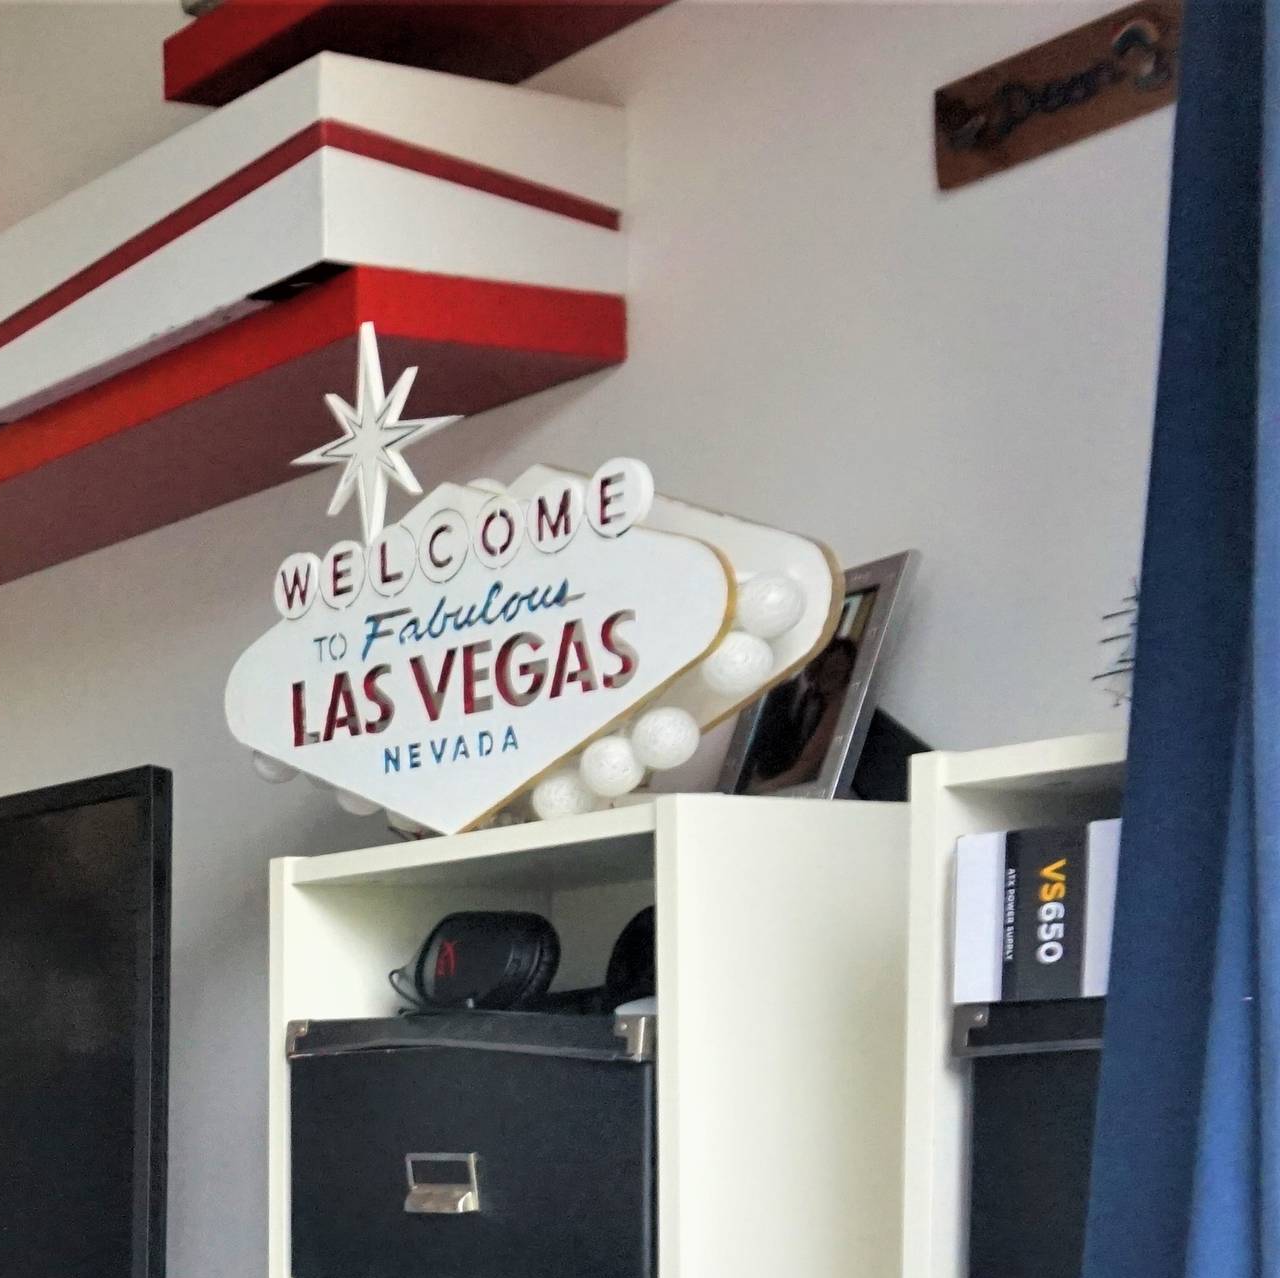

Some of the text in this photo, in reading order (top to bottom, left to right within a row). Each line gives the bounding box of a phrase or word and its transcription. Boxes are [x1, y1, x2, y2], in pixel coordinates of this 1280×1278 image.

[280, 470, 627, 611] WELCOME
[312, 577, 586, 664] TO Fabulous
[291, 607, 642, 748] LAS VEGAS
[382, 723, 520, 775] NEVADA
[1004, 867, 1017, 961] ATX POWER SUPPLY
[1038, 857, 1068, 966] VS650
